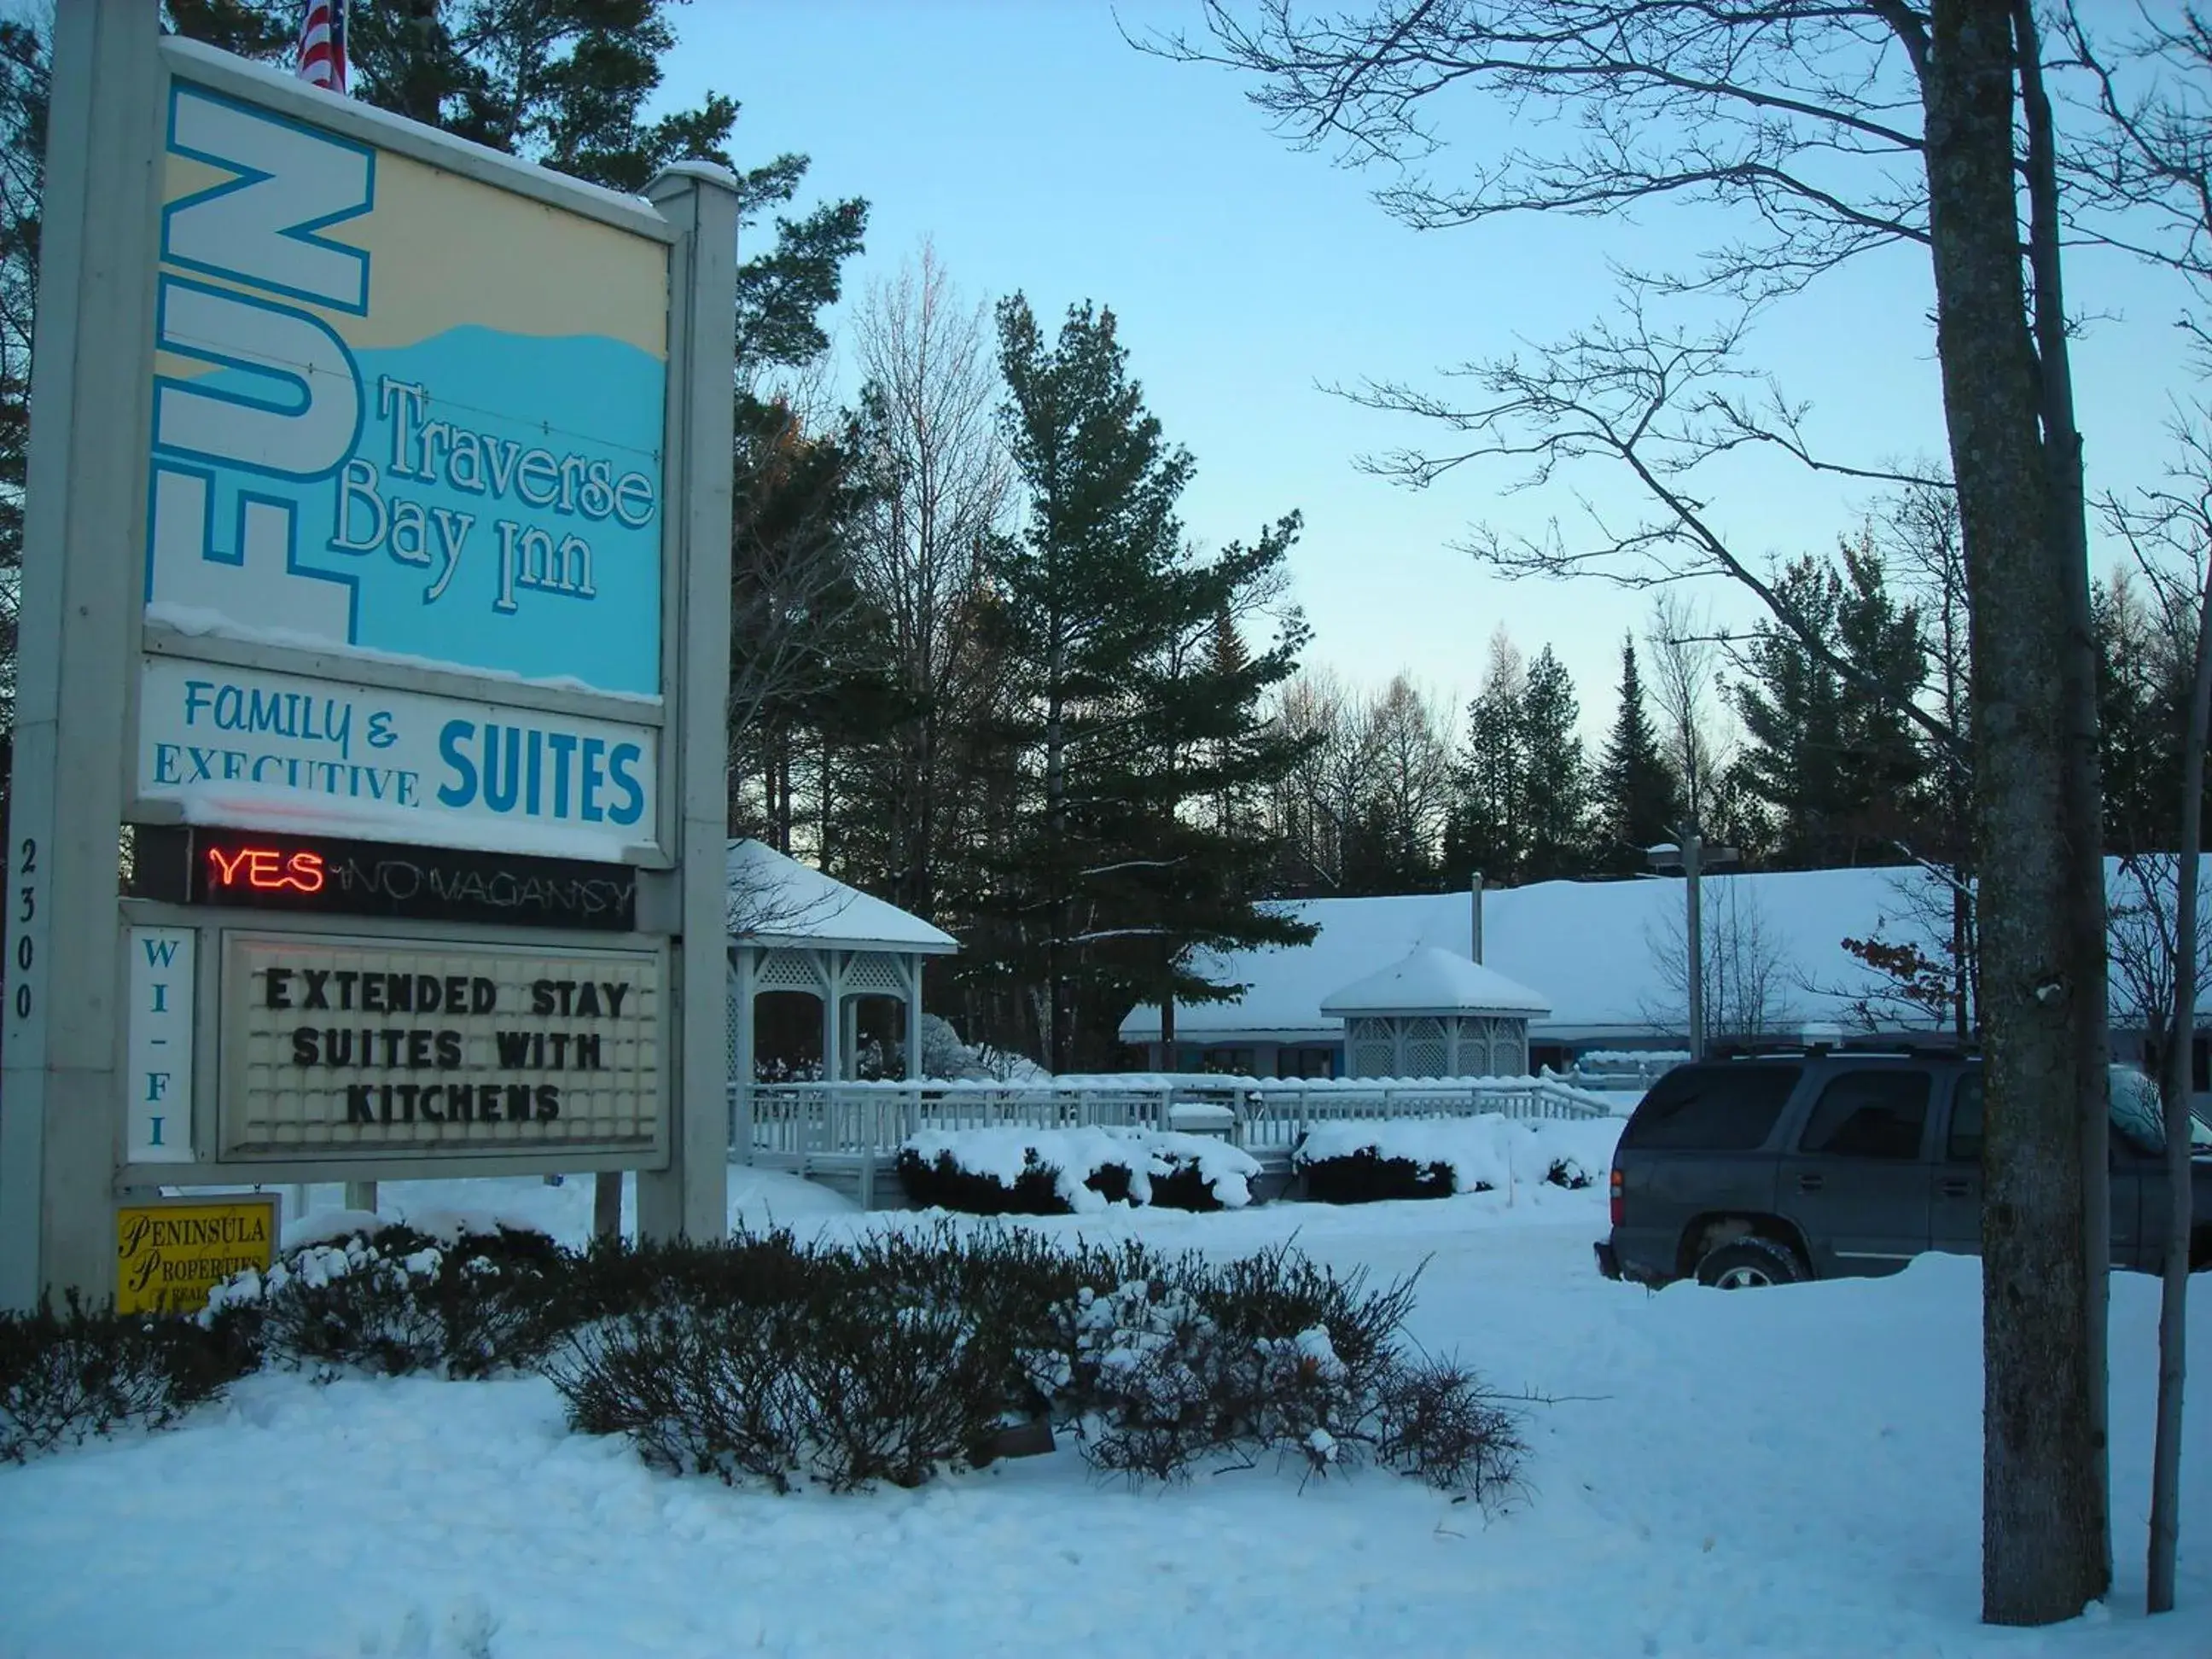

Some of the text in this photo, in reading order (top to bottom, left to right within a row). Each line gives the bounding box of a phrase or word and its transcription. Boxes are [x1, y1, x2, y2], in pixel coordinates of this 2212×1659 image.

[147, 84, 376, 647] FUN
[377, 374, 655, 530] Traverse
[327, 457, 597, 615] Bay Inn
[367, 711, 399, 749] &
[436, 719, 644, 826] SUITES
[210, 847, 325, 894] YES
[341, 857, 423, 900] NO
[16, 838, 36, 1019] 2300
[265, 967, 630, 1019] EXTENDED STAY
[142, 939, 181, 1145] WI-FI
[292, 1026, 602, 1071] SUITES WITH
[346, 1084, 561, 1124] KITCHENS
[118, 1214, 266, 1259] PENINSULA
